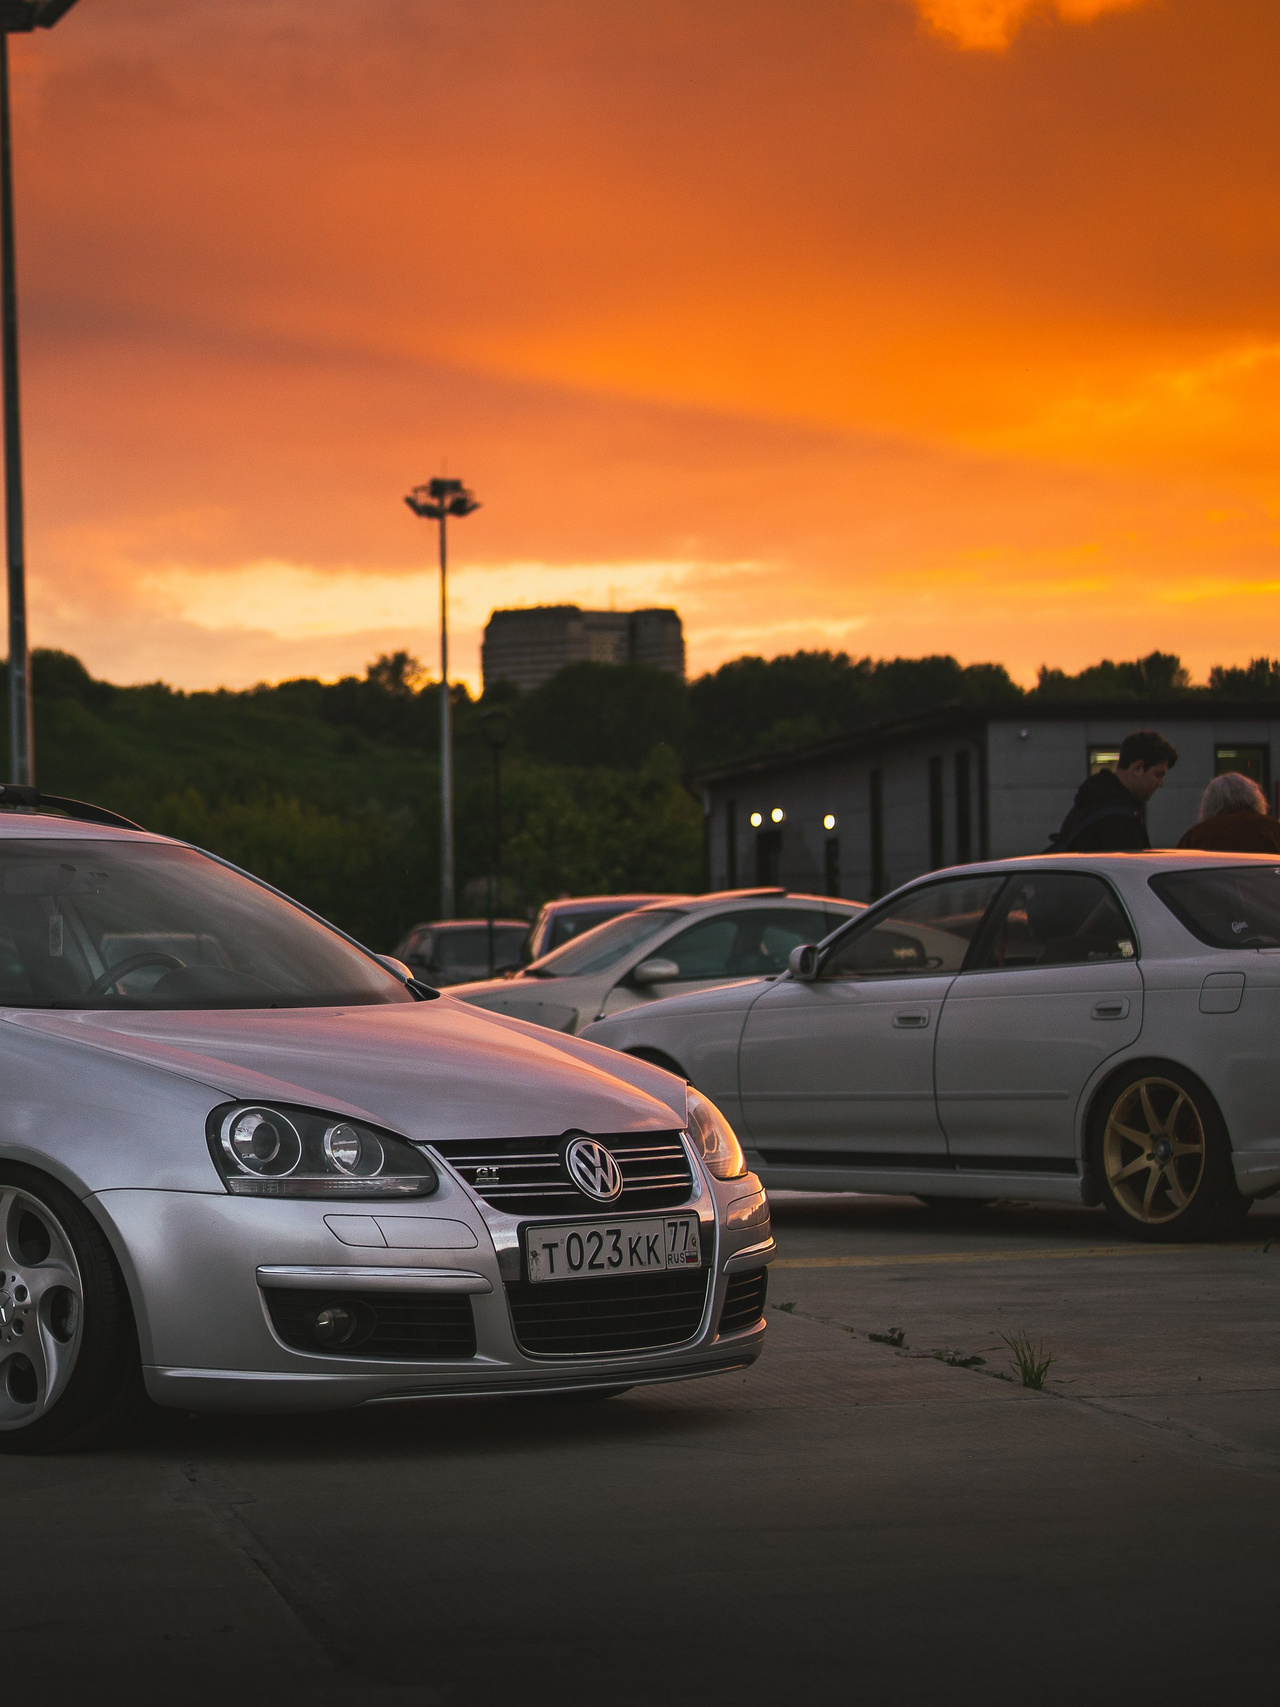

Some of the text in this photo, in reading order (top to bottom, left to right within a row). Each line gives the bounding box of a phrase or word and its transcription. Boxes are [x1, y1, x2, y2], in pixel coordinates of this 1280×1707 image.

[476, 1167, 499, 1178] GT
[667, 1220, 690, 1252] 77
[667, 1253, 686, 1265] RUS
